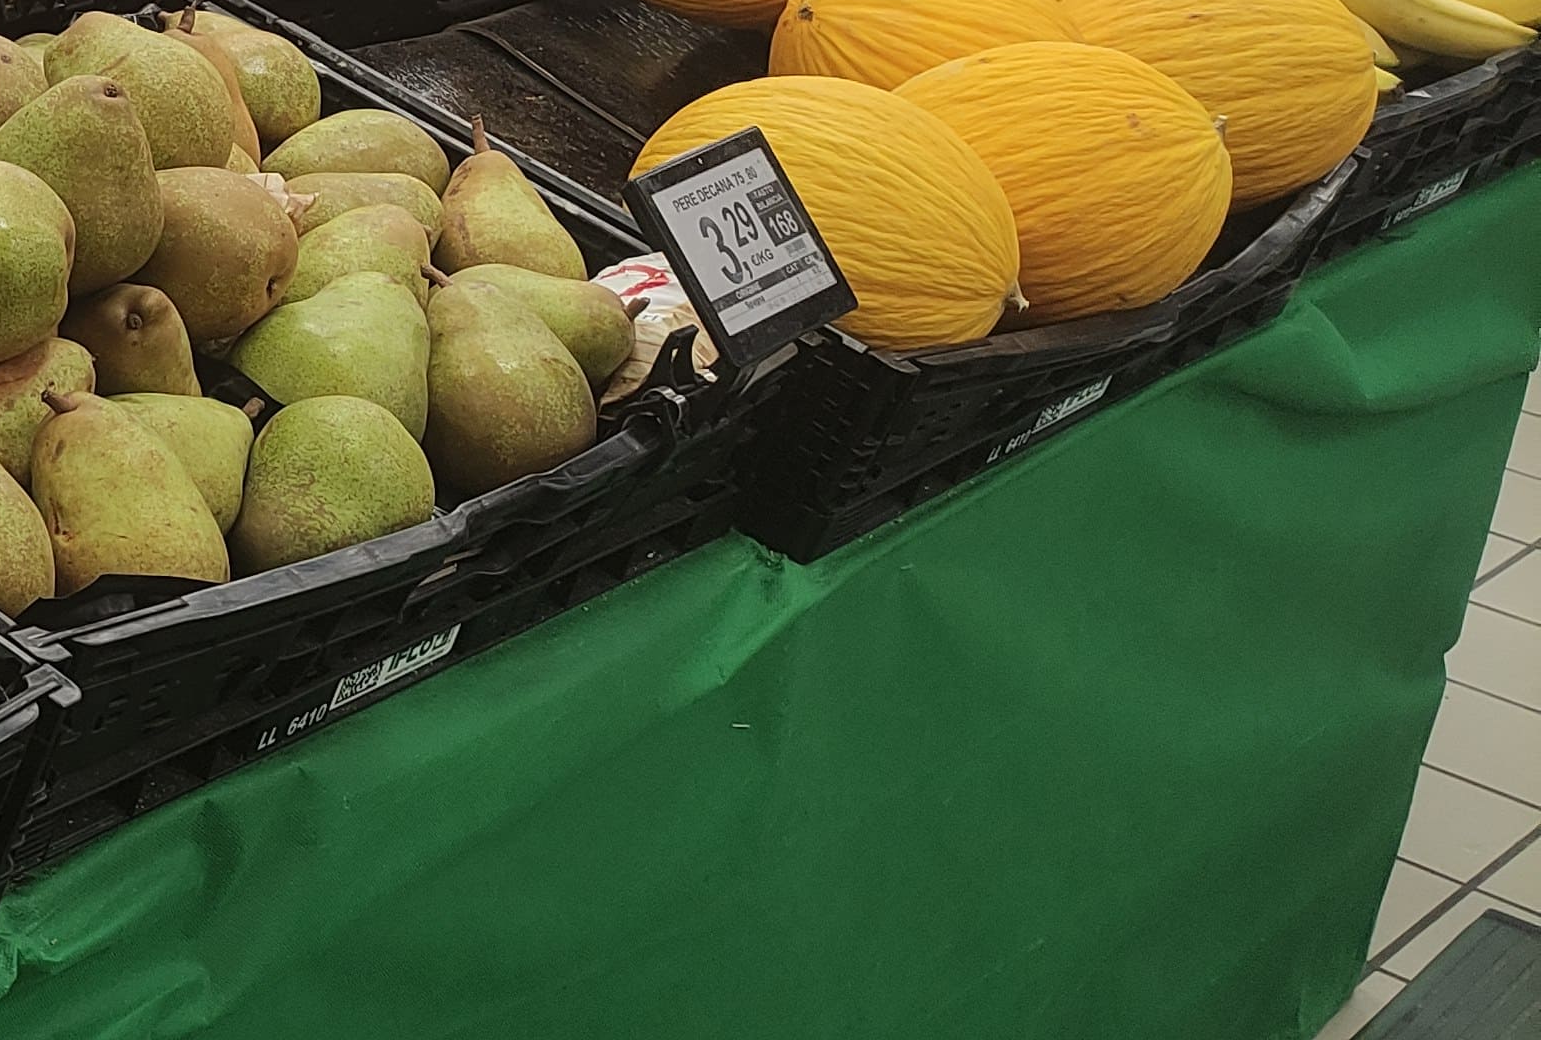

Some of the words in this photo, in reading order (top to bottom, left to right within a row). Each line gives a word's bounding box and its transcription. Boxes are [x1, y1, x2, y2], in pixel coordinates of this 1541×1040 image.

[672, 191, 700, 213] PERE
[697, 177, 736, 203] DECANA
[698, 201, 759, 285] 3,29
[769, 210, 799, 240] 168
[257, 726, 278, 751] LL
[286, 703, 328, 737] 6410
